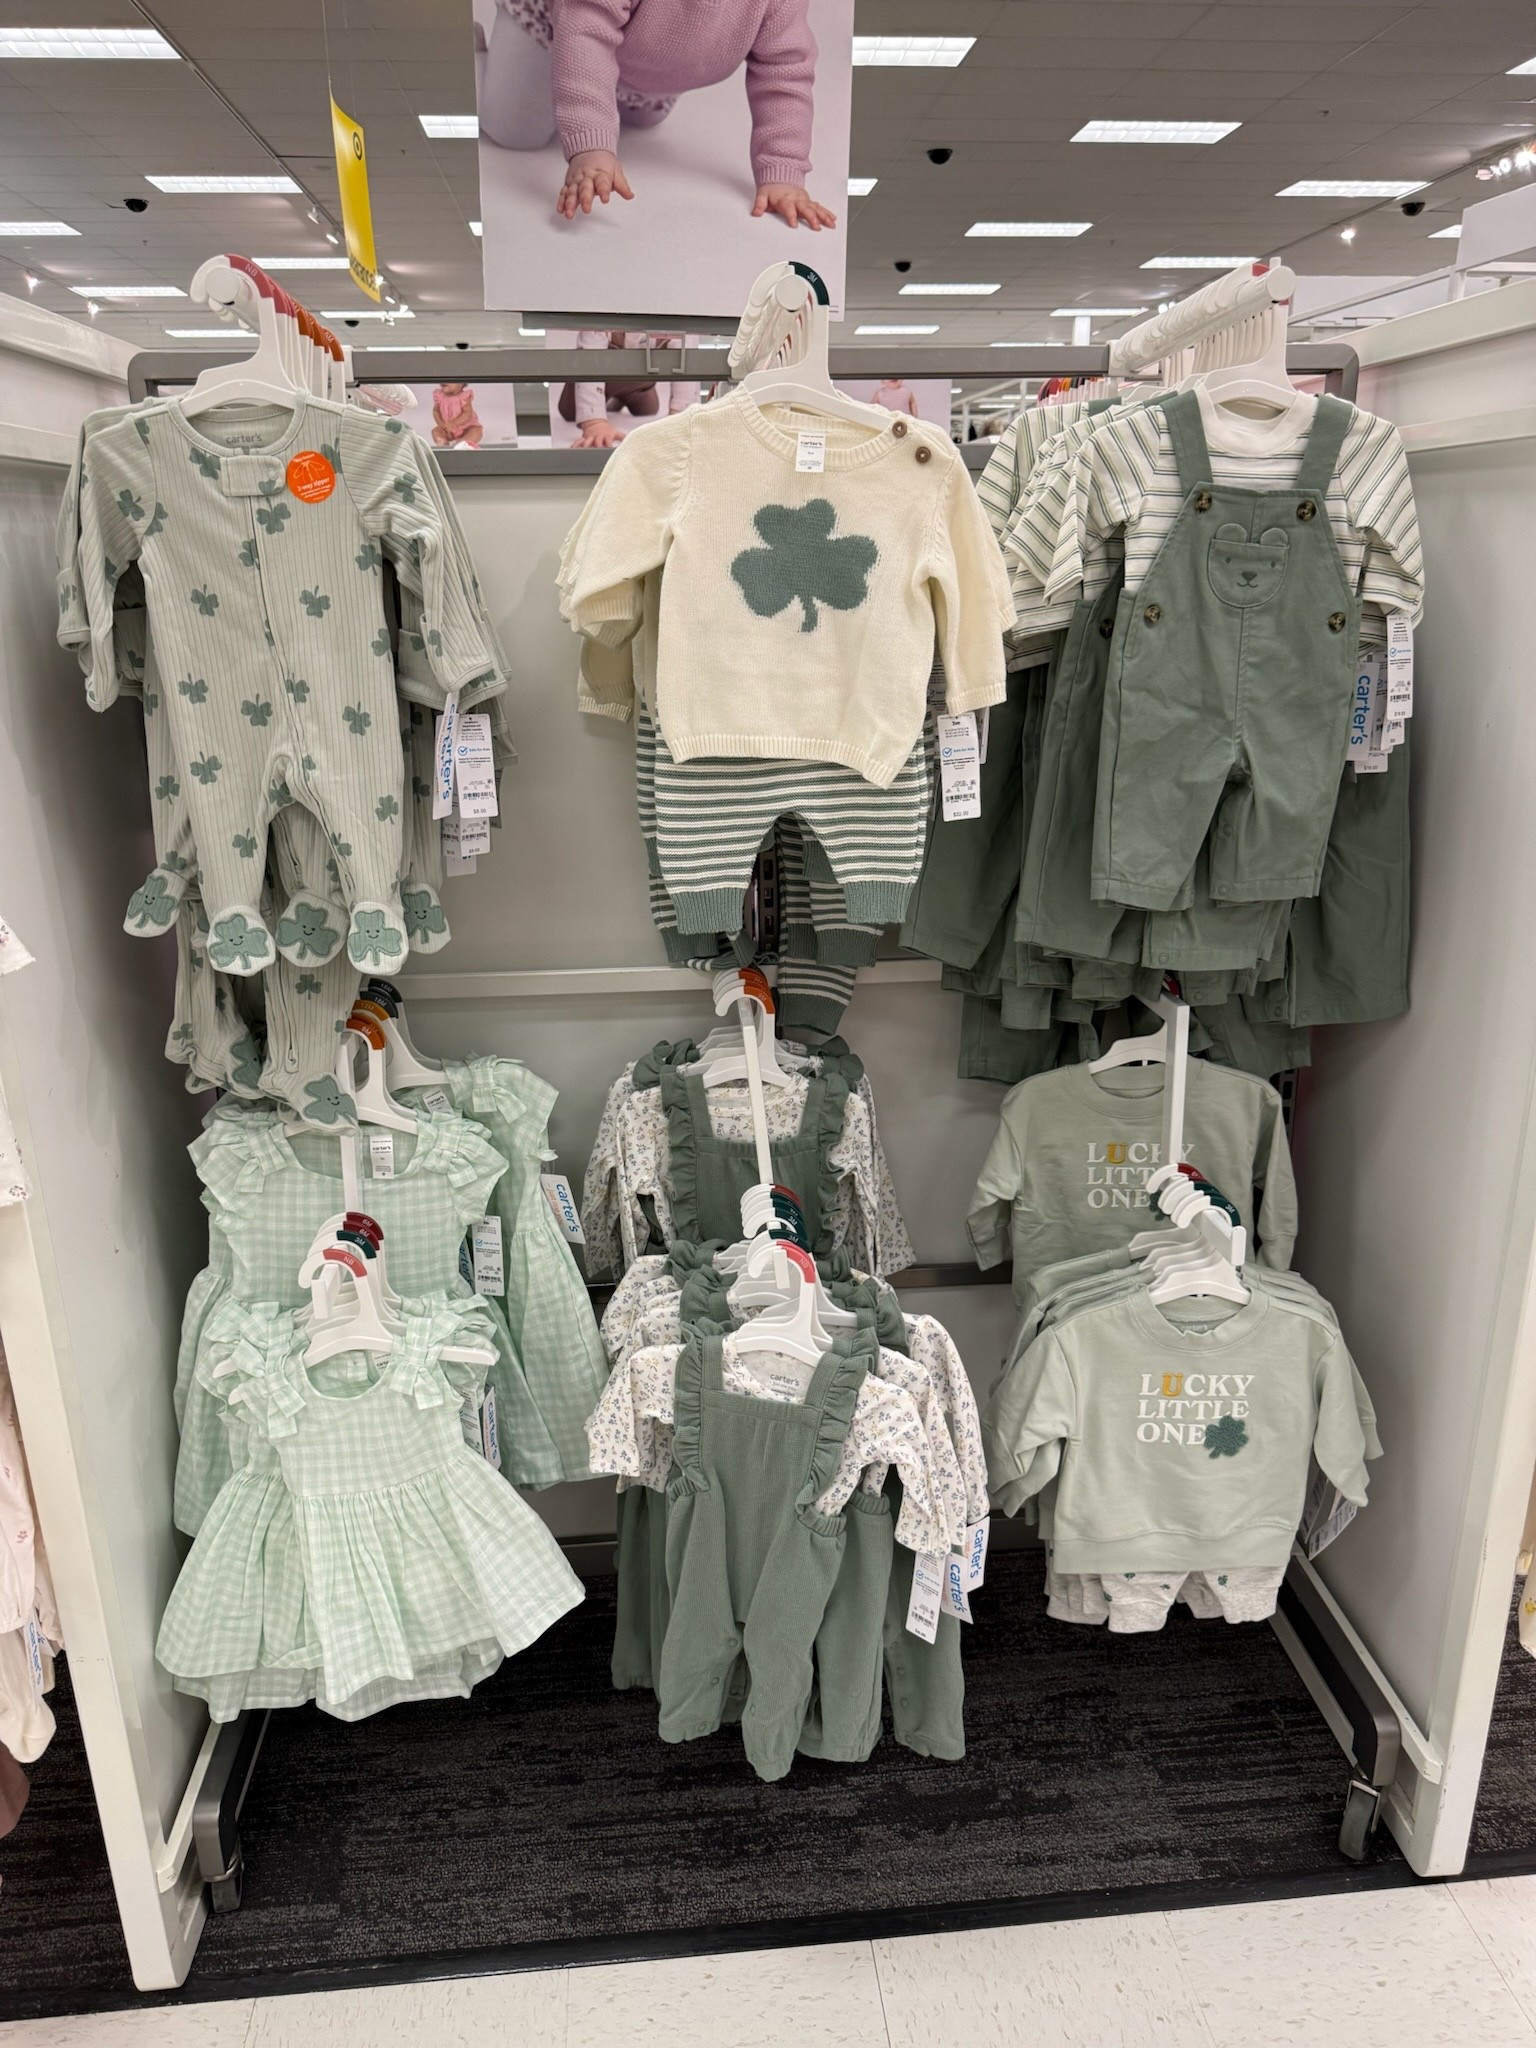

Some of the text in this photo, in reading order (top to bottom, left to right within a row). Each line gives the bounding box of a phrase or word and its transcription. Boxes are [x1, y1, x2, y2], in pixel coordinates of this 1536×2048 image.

[245, 263, 259, 277] NB
[807, 272, 818, 284] 3M
[226, 434, 263, 445] carter's
[1350, 675, 1371, 746] carter's
[1087, 1166, 1157, 1185] LITT
[1087, 1188, 1151, 1210] ONE
[556, 1183, 580, 1233] carter's
[1225, 1204, 1235, 1213] 3M
[787, 1216, 798, 1226] 3M
[354, 1236, 366, 1246] 3M
[343, 1256, 355, 1265] NB
[800, 1257, 809, 1268] NB
[770, 1374, 800, 1387] carter's
[1138, 1371, 1256, 1397] LUCKY
[1137, 1399, 1250, 1420] LITTLE
[1136, 1422, 1207, 1445] ONE
[969, 1528, 984, 1579] carter's
[950, 1563, 968, 1613] carter's
